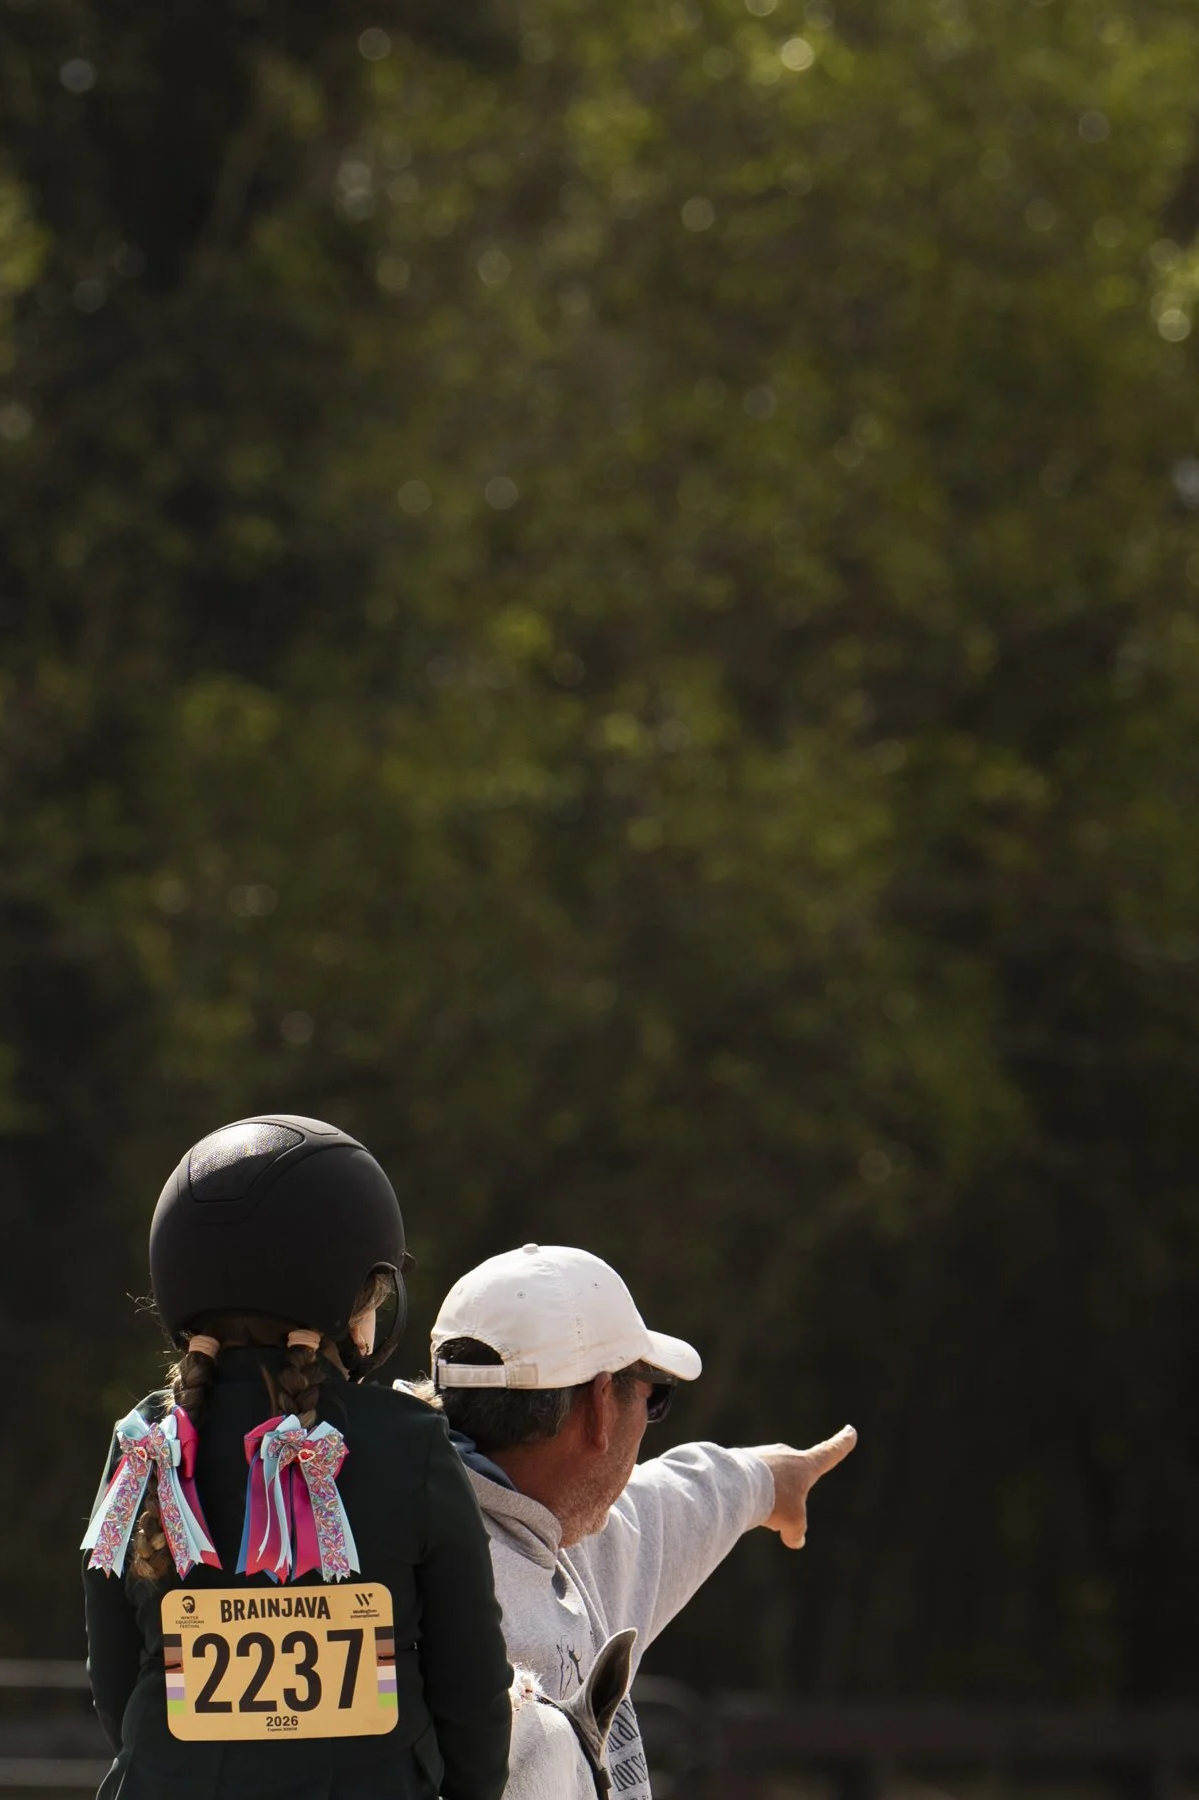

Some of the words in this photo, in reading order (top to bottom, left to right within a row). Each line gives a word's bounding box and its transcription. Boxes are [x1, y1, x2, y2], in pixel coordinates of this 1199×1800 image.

[220, 1596, 332, 1623] BRAINJAVA
[192, 1629, 364, 1713] 2237
[266, 1715, 299, 1727] 2026
